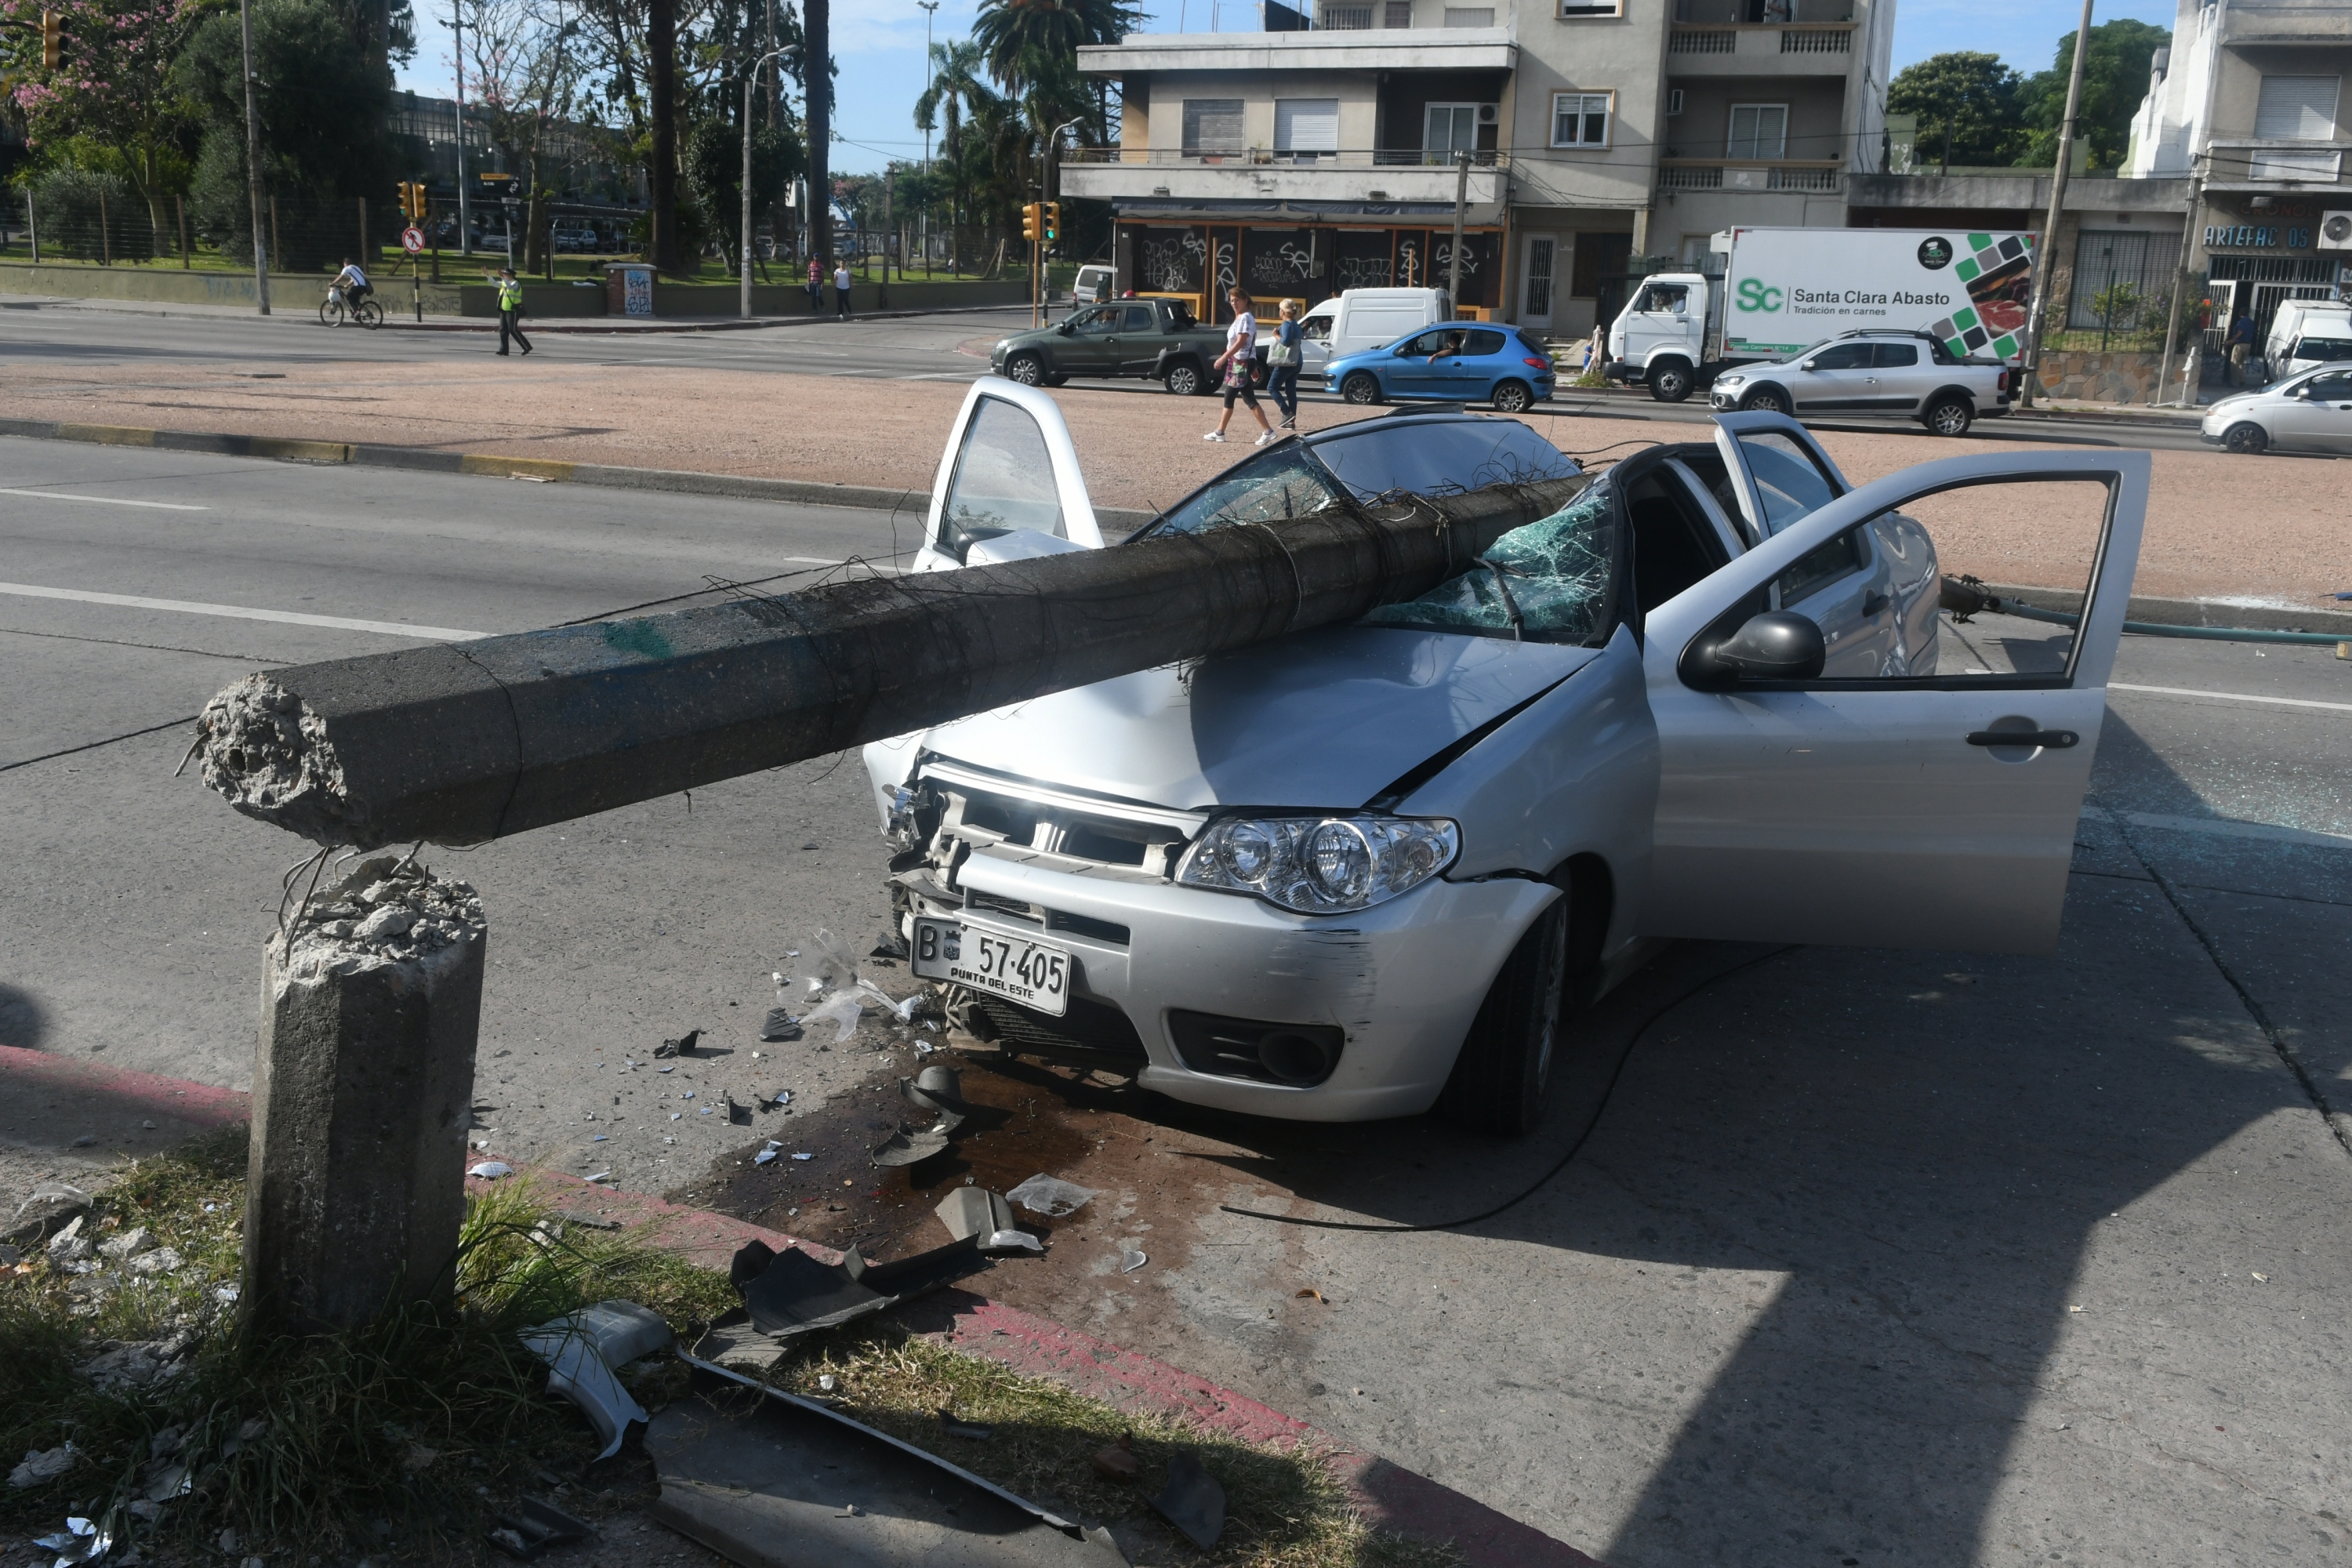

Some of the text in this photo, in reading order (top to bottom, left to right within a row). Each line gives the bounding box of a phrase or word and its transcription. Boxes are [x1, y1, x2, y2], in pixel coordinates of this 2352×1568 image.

[1794, 289, 1950, 305] Santa Clara Abasto
[1794, 306, 1835, 314] Tradición
[919, 925, 937, 961] B
[950, 967, 1035, 1000] PUNTA DEL ESTE
